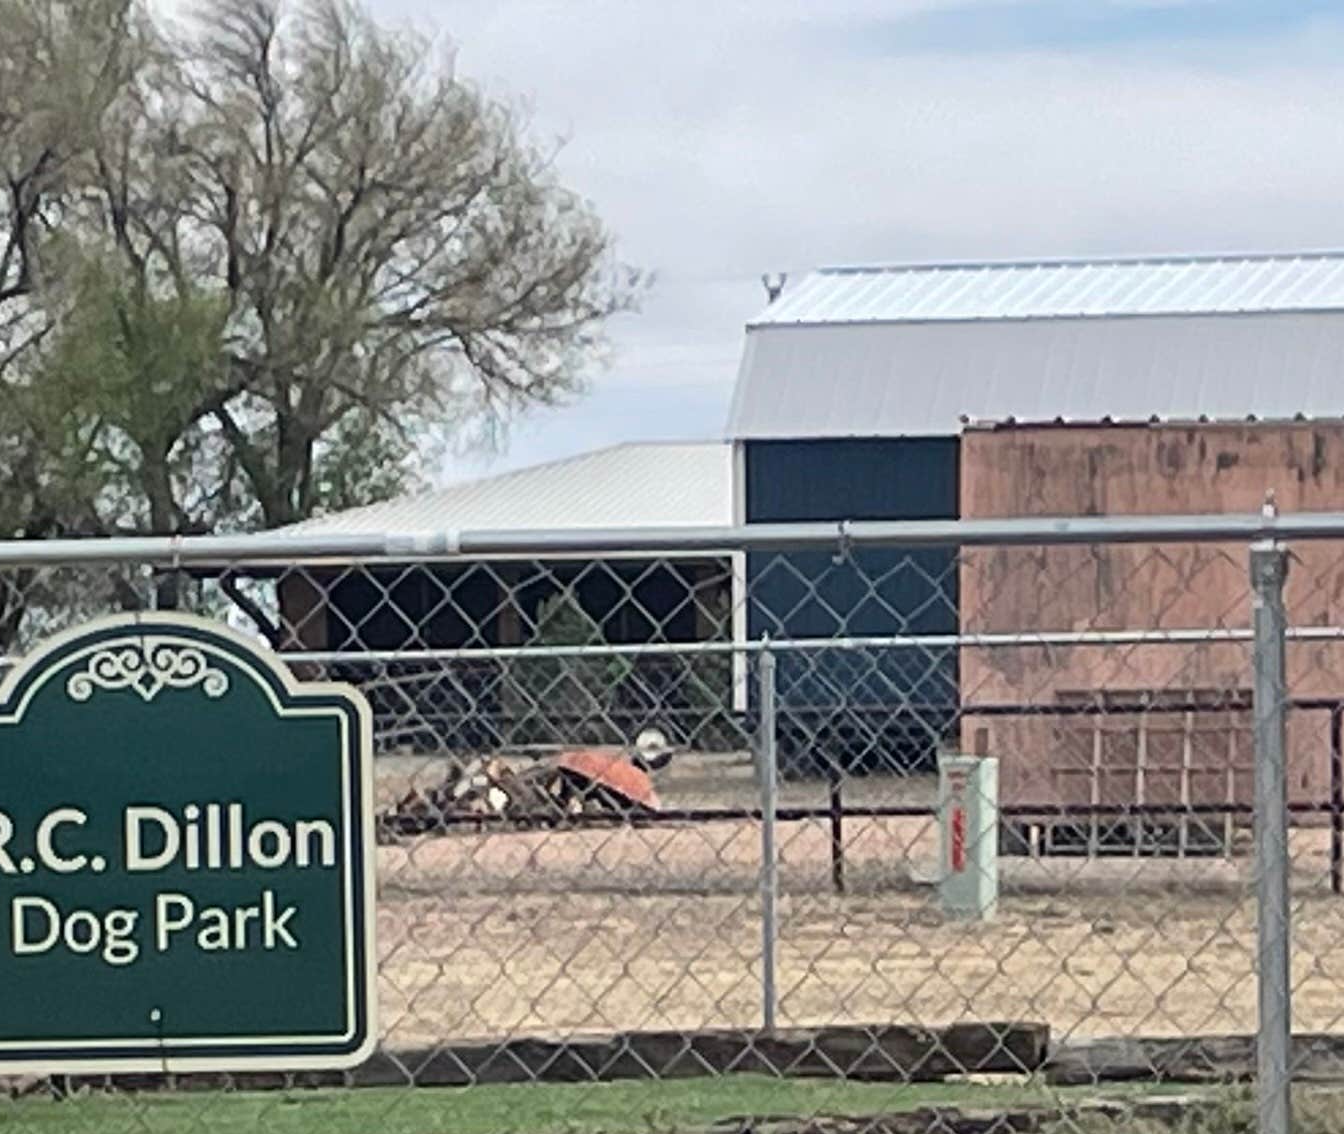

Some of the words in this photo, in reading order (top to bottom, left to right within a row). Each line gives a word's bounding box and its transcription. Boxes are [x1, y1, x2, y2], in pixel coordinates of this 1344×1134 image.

[125, 803, 336, 871] Dillon
[12, 896, 139, 965] Dog
[155, 890, 298, 952] Park
